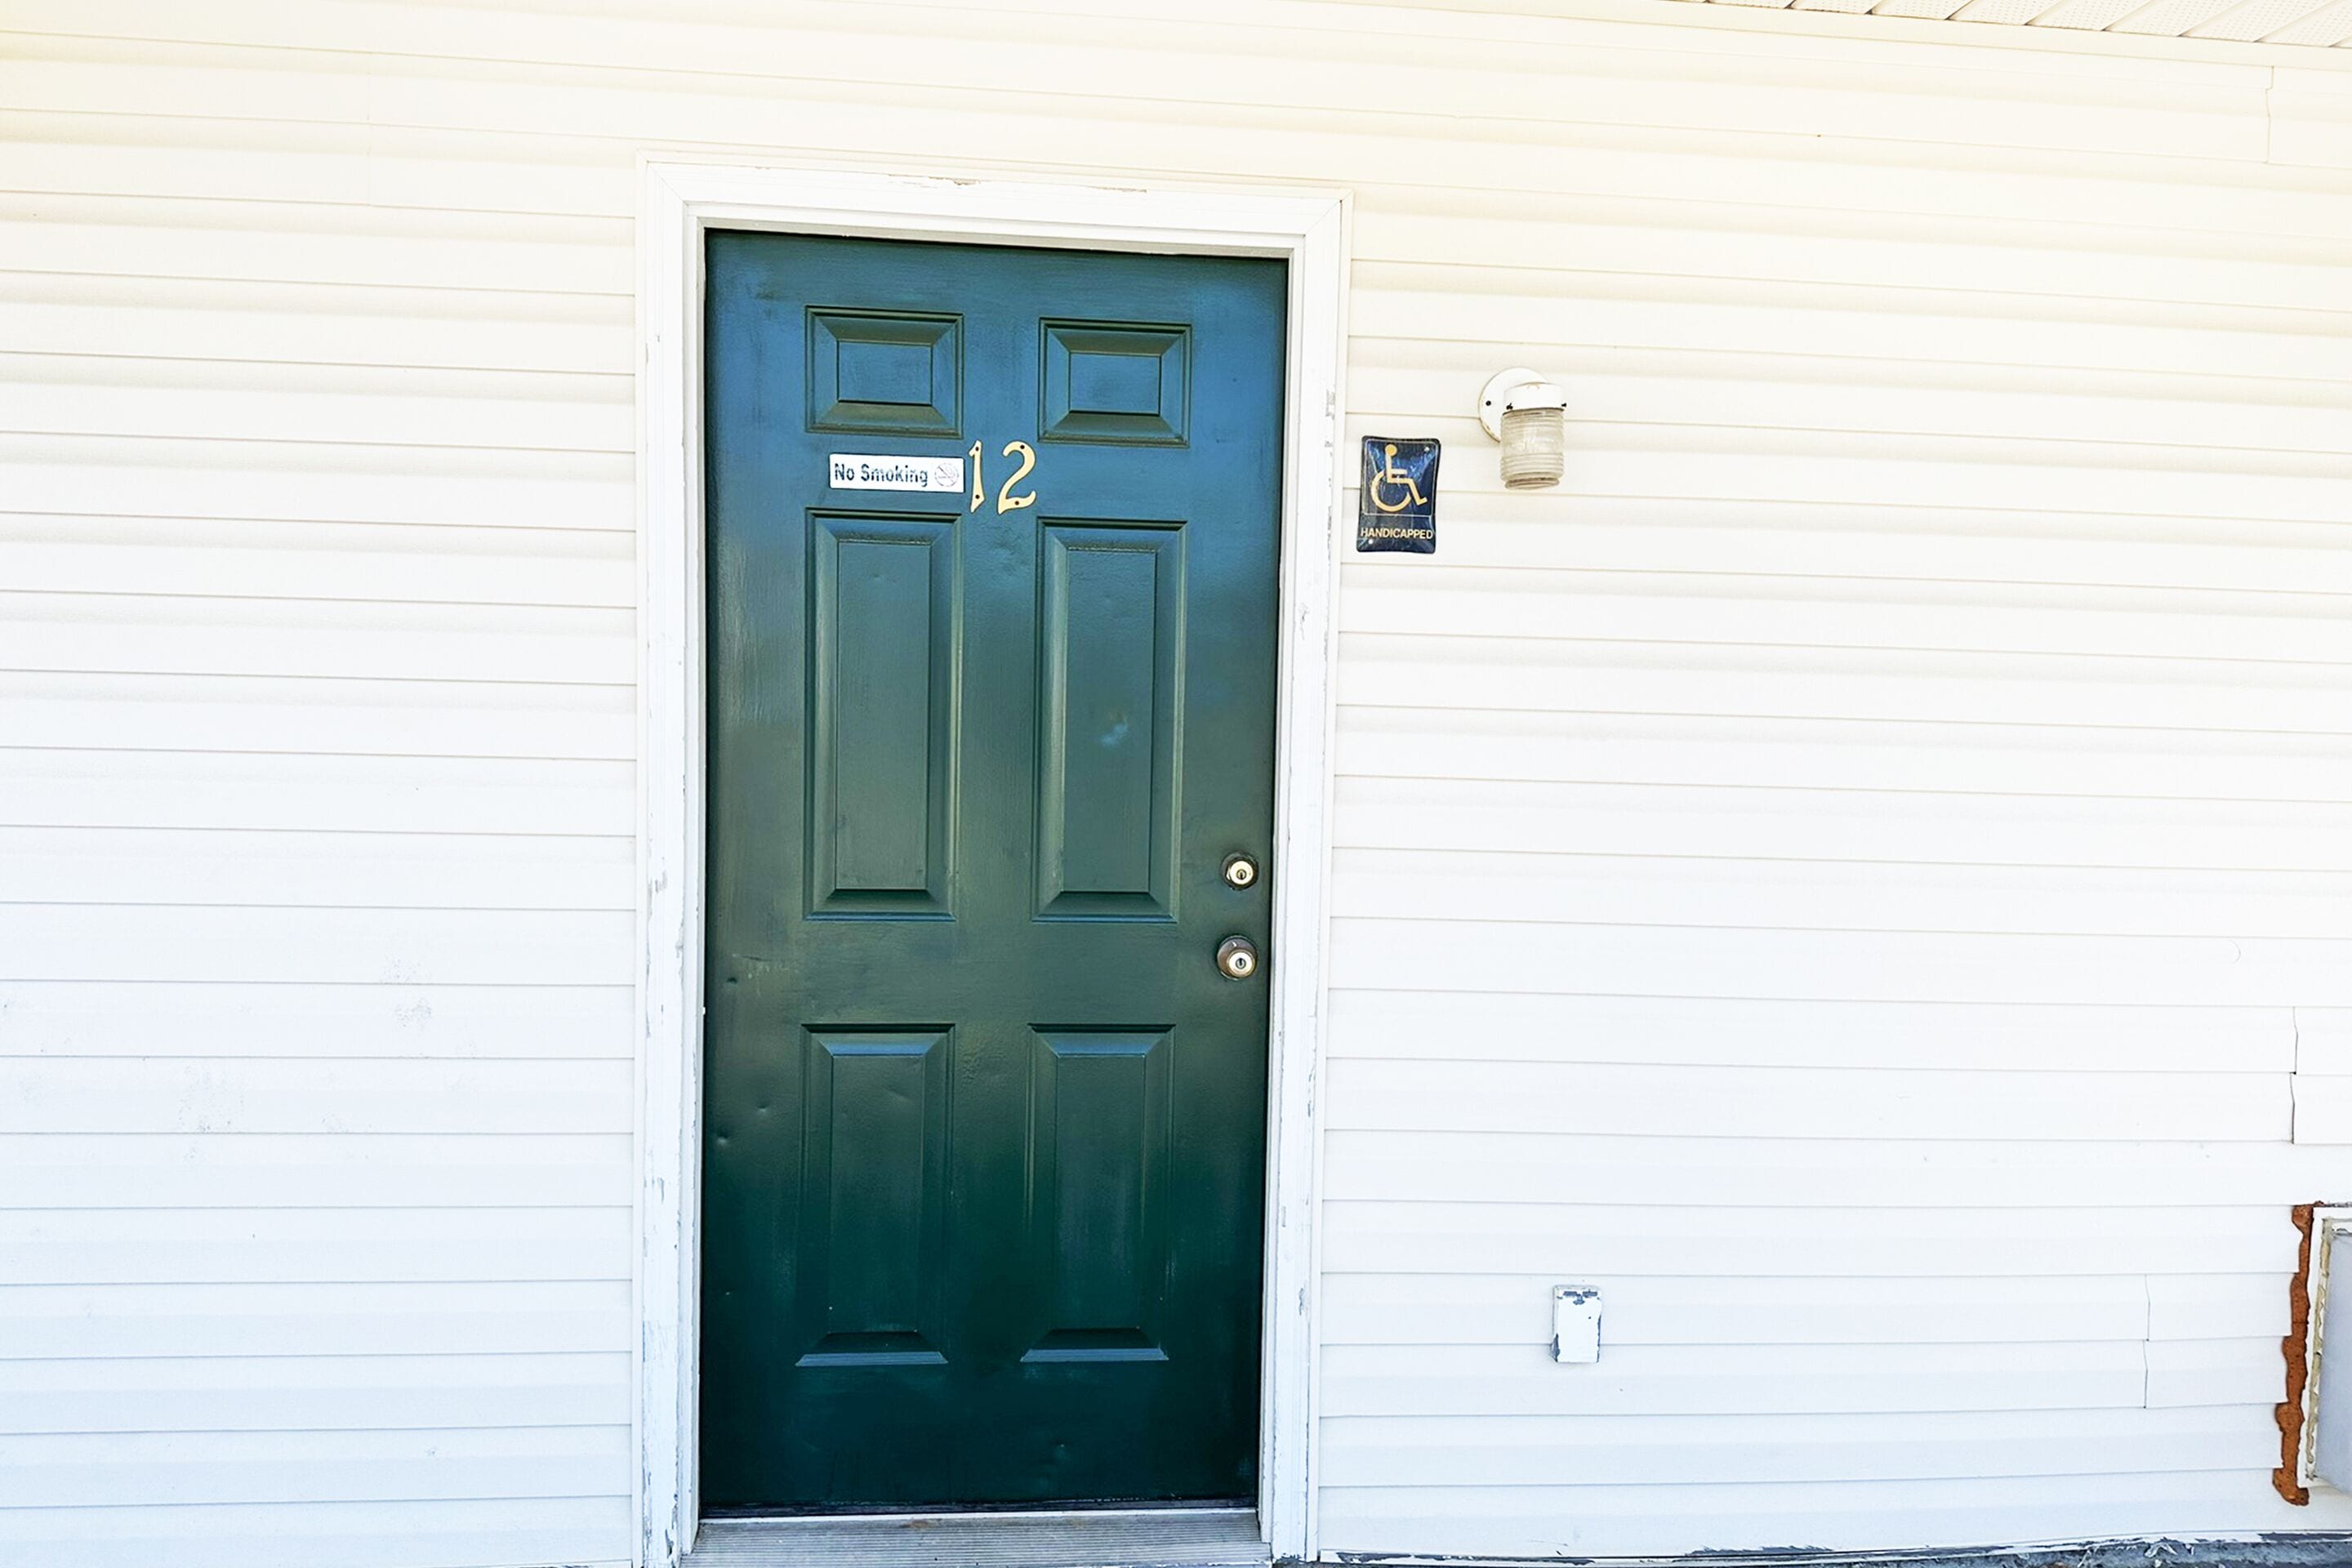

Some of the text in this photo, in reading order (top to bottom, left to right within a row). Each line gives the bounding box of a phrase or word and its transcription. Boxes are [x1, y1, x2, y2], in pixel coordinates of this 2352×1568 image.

[834, 463, 929, 488] No Smoking
[968, 440, 1037, 515] 12
[1361, 527, 1433, 539] HANDICAPPED
